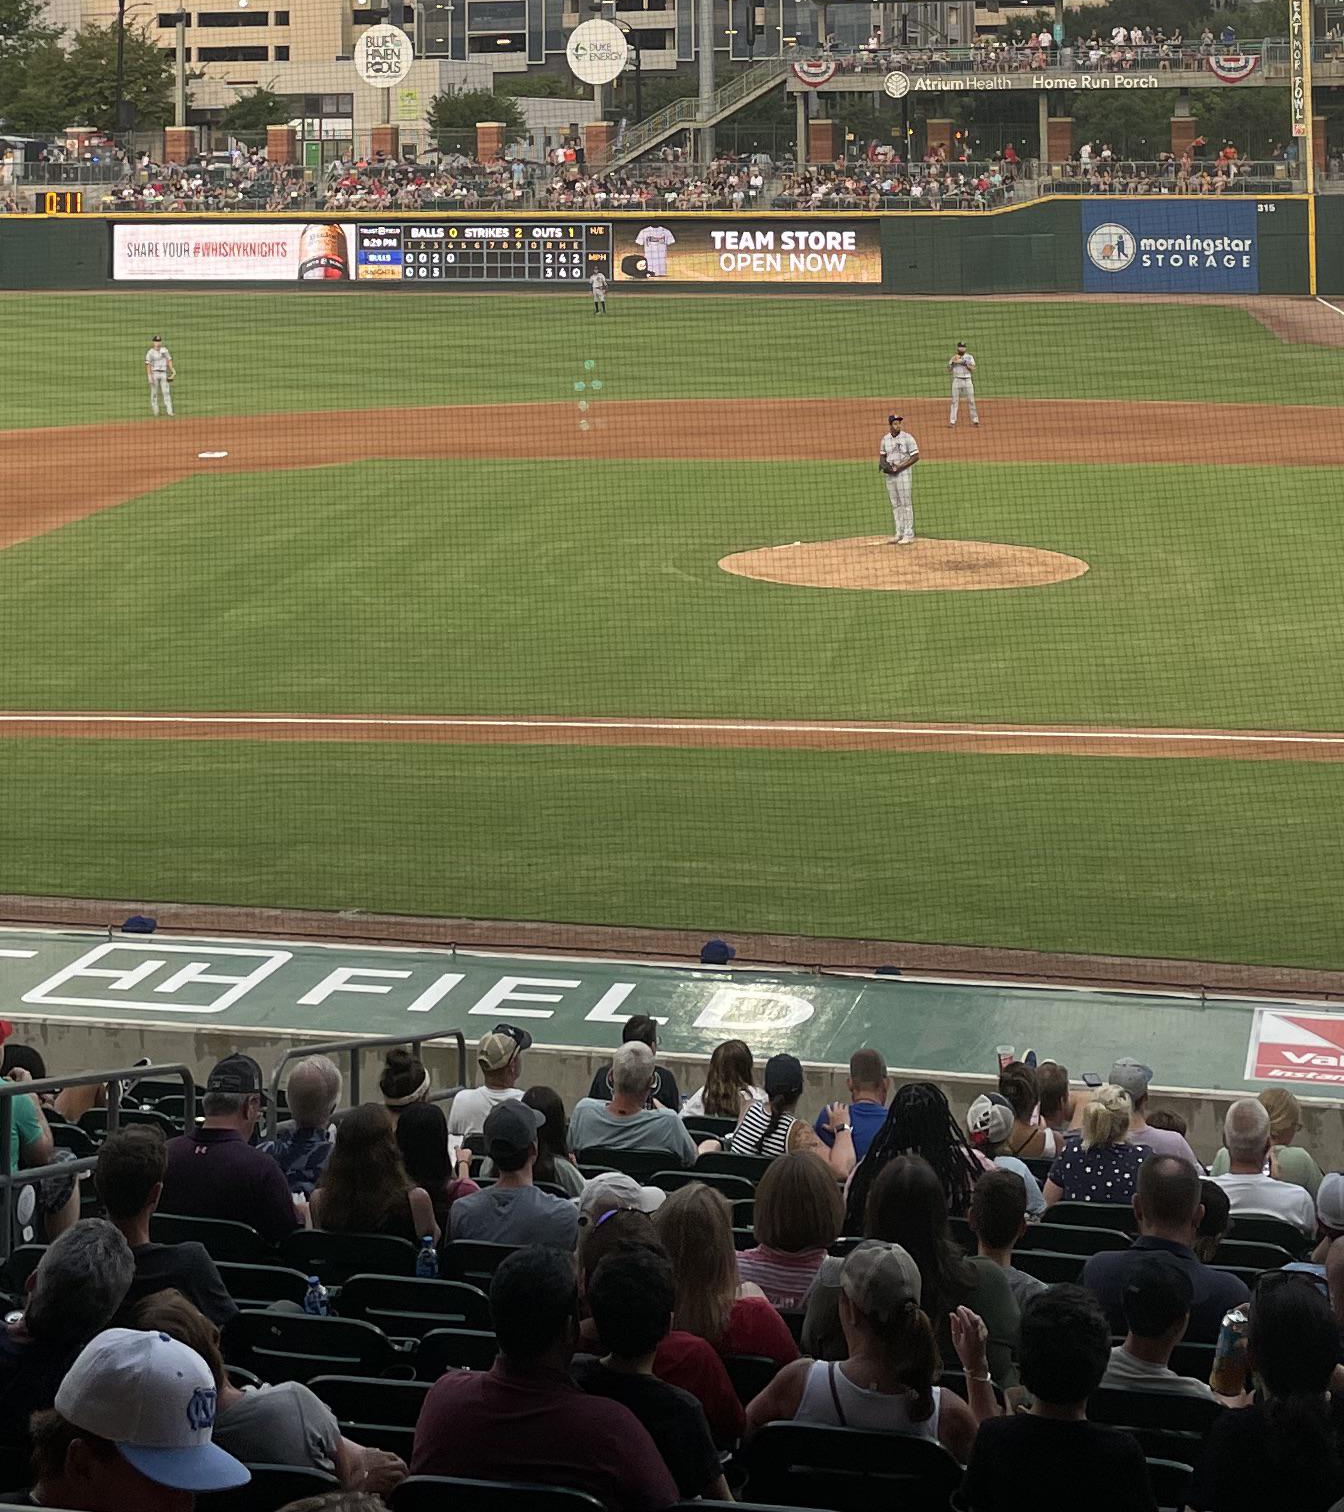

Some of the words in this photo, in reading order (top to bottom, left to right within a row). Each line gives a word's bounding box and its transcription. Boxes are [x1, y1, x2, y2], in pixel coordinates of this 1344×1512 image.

[366, 35, 392, 47] BLUE
[590, 42, 612, 52] DUKE
[366, 49, 401, 60] HAVEN
[590, 52, 622, 61] ENERGY
[366, 61, 401, 73] POOLS
[914, 77, 964, 90] Atrium
[966, 77, 1012, 90] Health
[1033, 75, 1077, 88] Home
[1081, 75, 1110, 88] Run
[1114, 75, 1159, 88] Porch
[1257, 203, 1275, 212] 315
[411, 228, 444, 238] BALLS
[449, 228, 458, 238] 0
[464, 228, 509, 238] STRIKES
[515, 228, 523, 238] 2
[532, 228, 562, 238] OUTS
[383, 238, 397, 247] PM
[710, 231, 775, 250] TEAM
[781, 231, 856, 250] STORE
[1140, 235, 1252, 255] morningstar
[127, 242, 159, 257] SHARE
[162, 242, 190, 257] YOUR
[193, 241, 288, 257] #WHISKYKNIGHTS
[405, 253, 414, 263] 0
[419, 253, 427, 263] 0
[432, 253, 439, 263] 2
[446, 253, 455, 263] 0
[545, 253, 552, 263] 2
[559, 253, 566, 263] 4
[572, 253, 580, 263] 2
[719, 253, 782, 272] OPEN
[789, 253, 847, 272] NOW
[1142, 255, 1251, 268] STORAGE
[405, 267, 414, 277] 0
[419, 267, 427, 277] 0
[545, 267, 552, 277] 3
[559, 267, 566, 277] 4
[572, 267, 580, 277] 0
[297, 965, 816, 1032] FIELD
